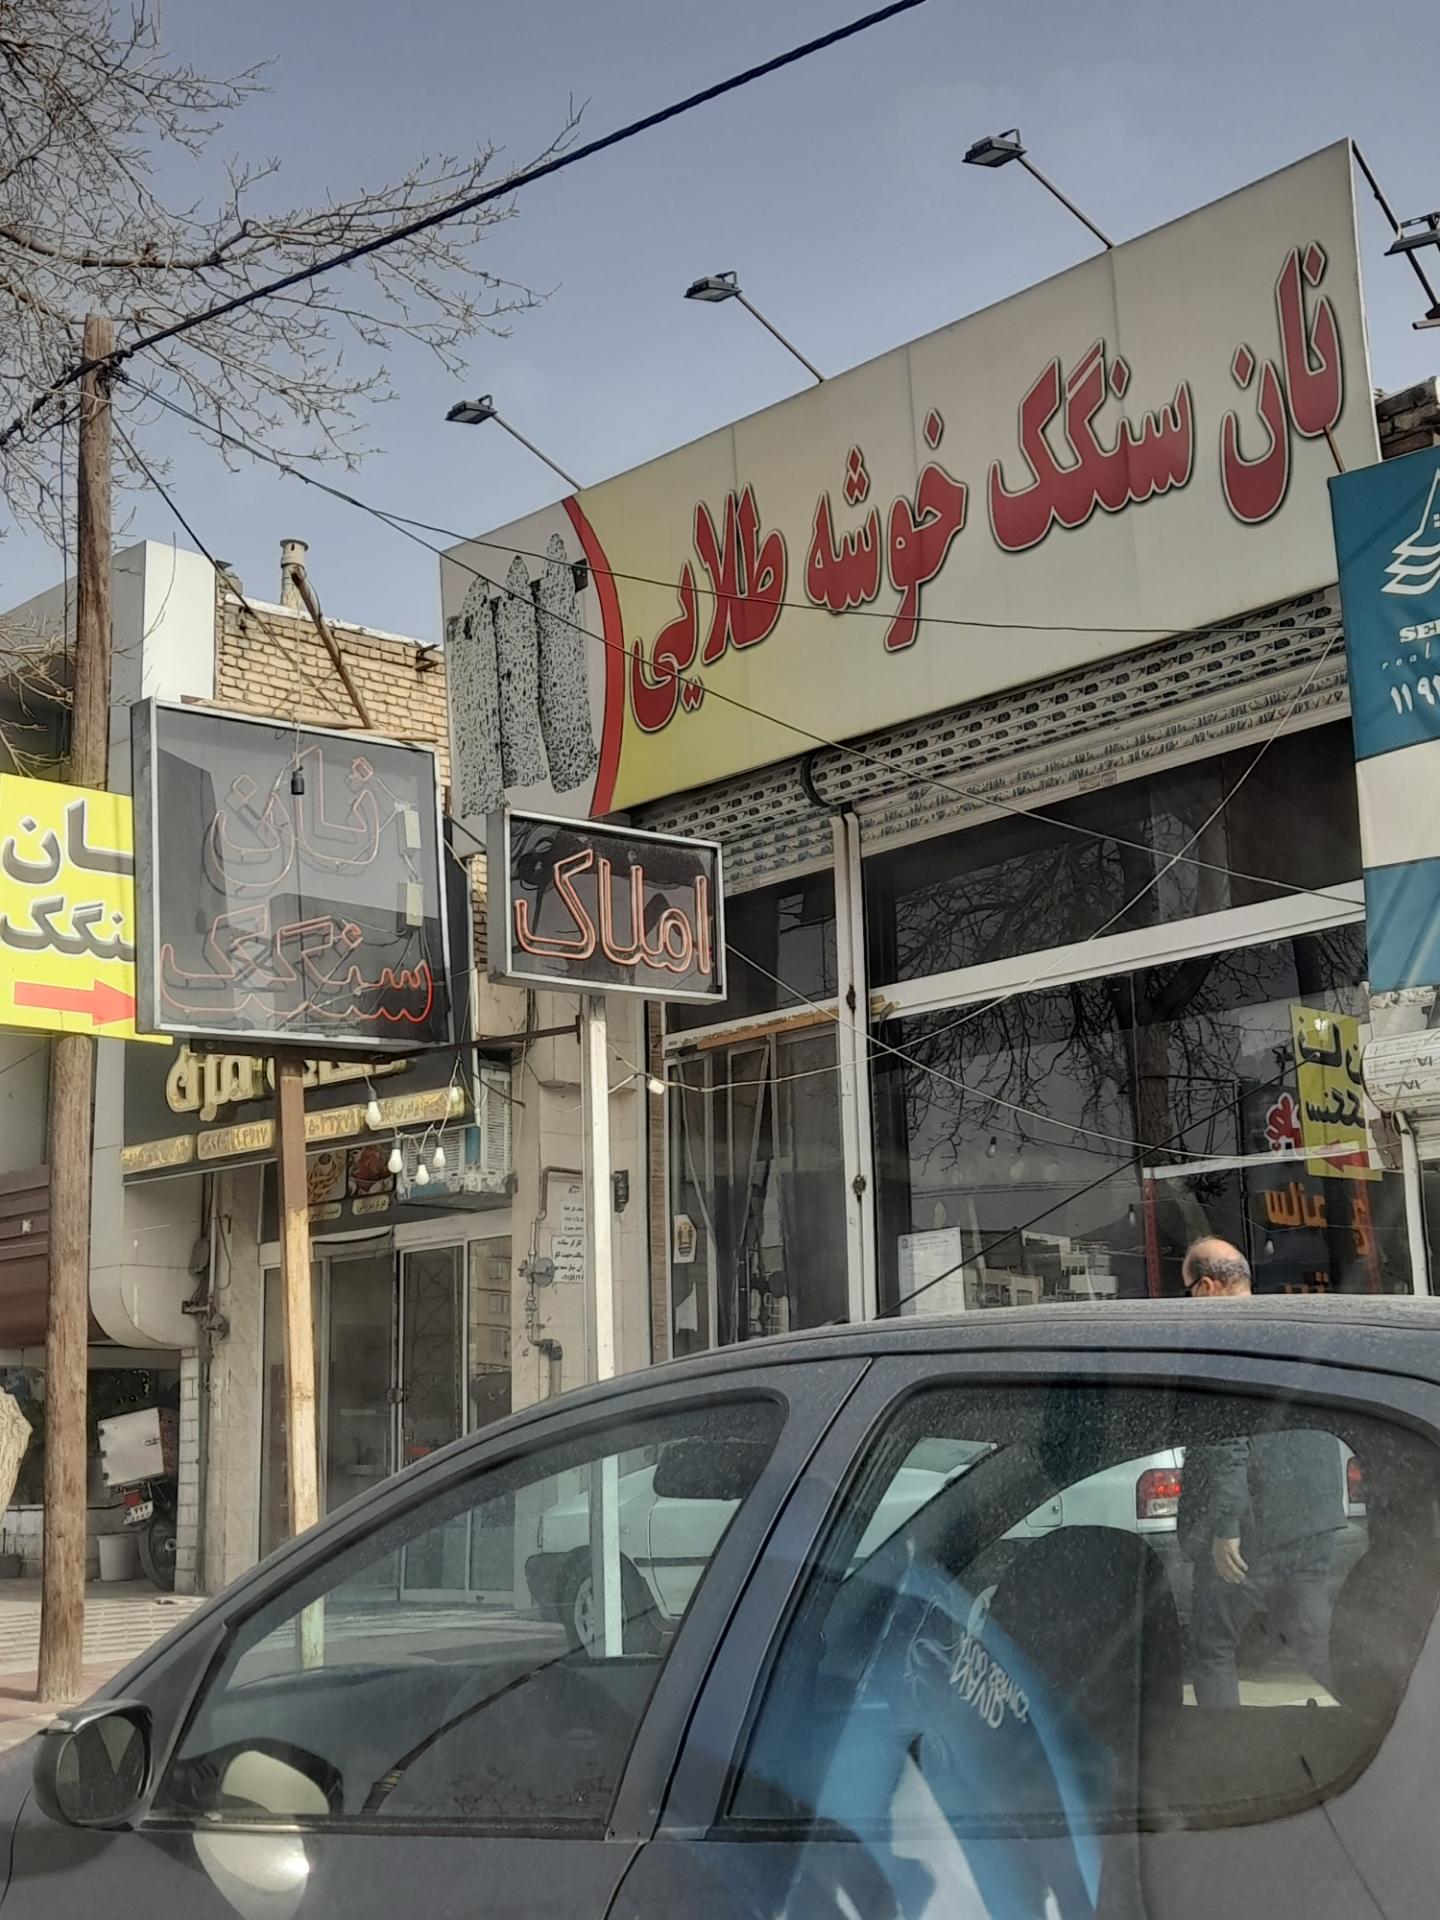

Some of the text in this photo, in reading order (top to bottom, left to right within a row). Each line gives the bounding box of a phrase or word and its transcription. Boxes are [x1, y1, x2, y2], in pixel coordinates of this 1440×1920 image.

[631, 242, 1346, 735] نان سنگک خوشه طلایی
[1399, 618, 1440, 644] SE
[2, 799, 135, 884] ان
[210, 746, 380, 888] نان
[0, 894, 136, 962] نگک
[159, 904, 433, 1023] سنگک
[515, 848, 711, 974] املاک
